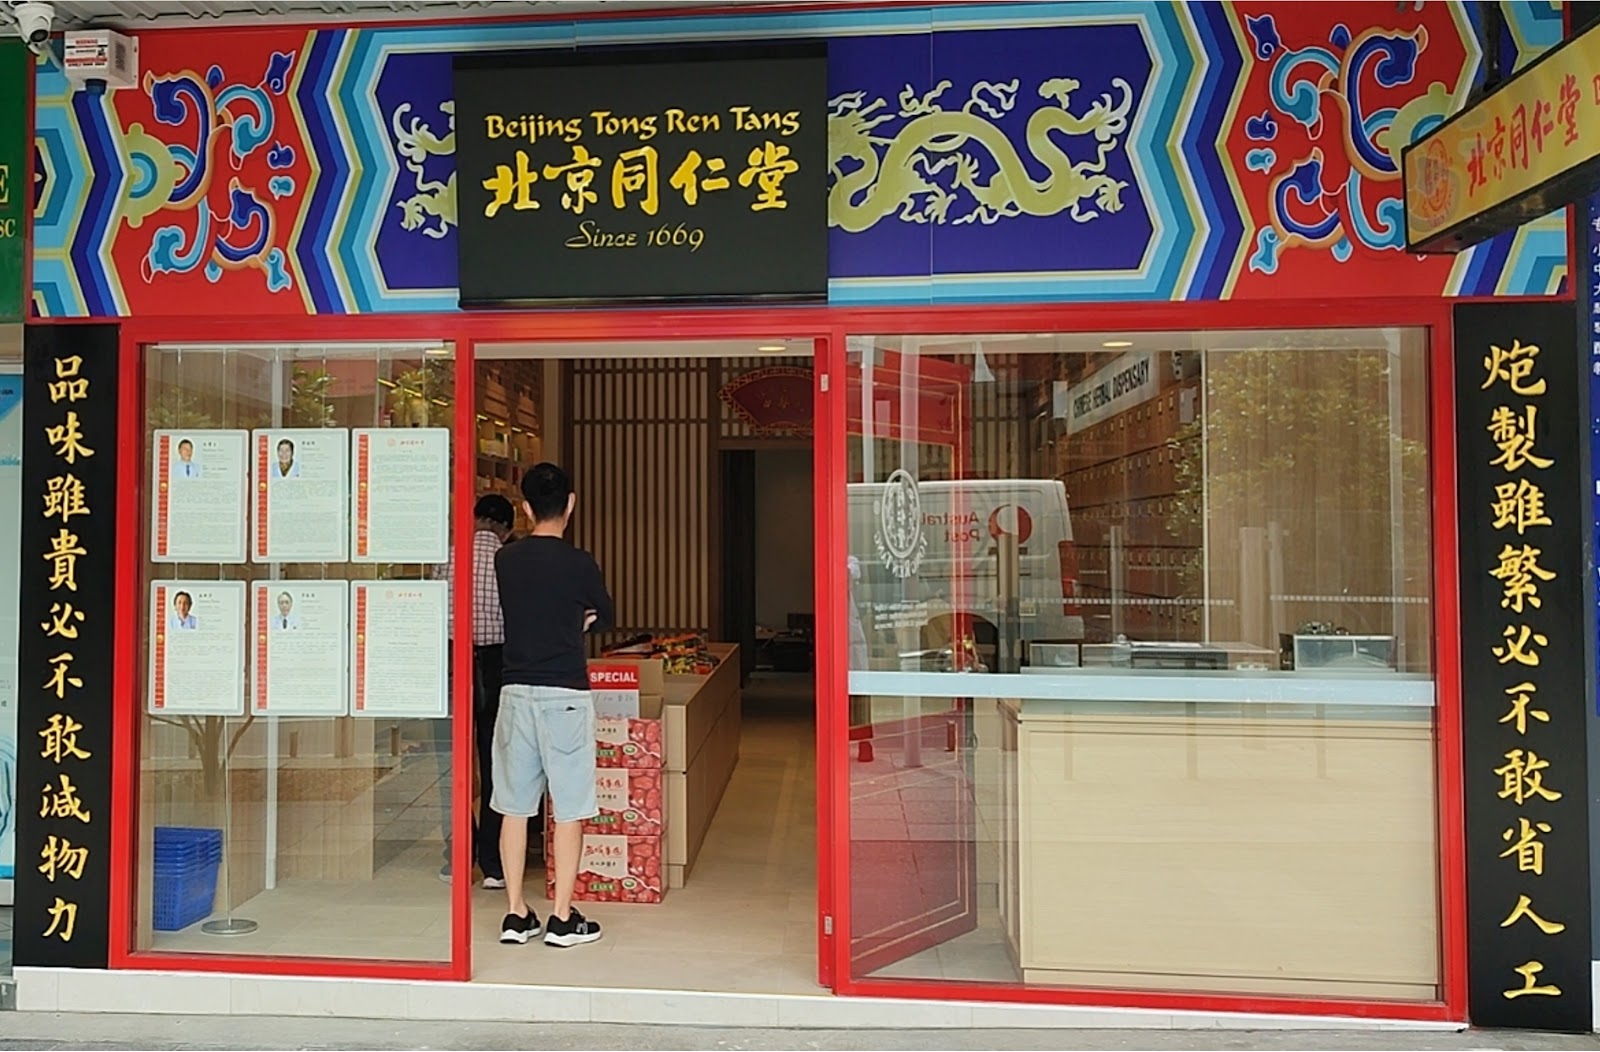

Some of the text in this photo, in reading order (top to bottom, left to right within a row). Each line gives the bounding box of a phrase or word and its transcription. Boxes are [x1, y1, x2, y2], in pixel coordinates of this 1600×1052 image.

[485, 106, 801, 143] Beijing Tong Ren Tang
[1467, 74, 1581, 197] 北京同仁堂
[481, 141, 800, 218] 北京同仁堂
[565, 220, 705, 252] Since 1669
[1113, 357, 1150, 399] DISPENSARY
[590, 671, 638, 683] SPECIAL
[1481, 339, 1565, 999] 炮製雖繁必不敢省人工
